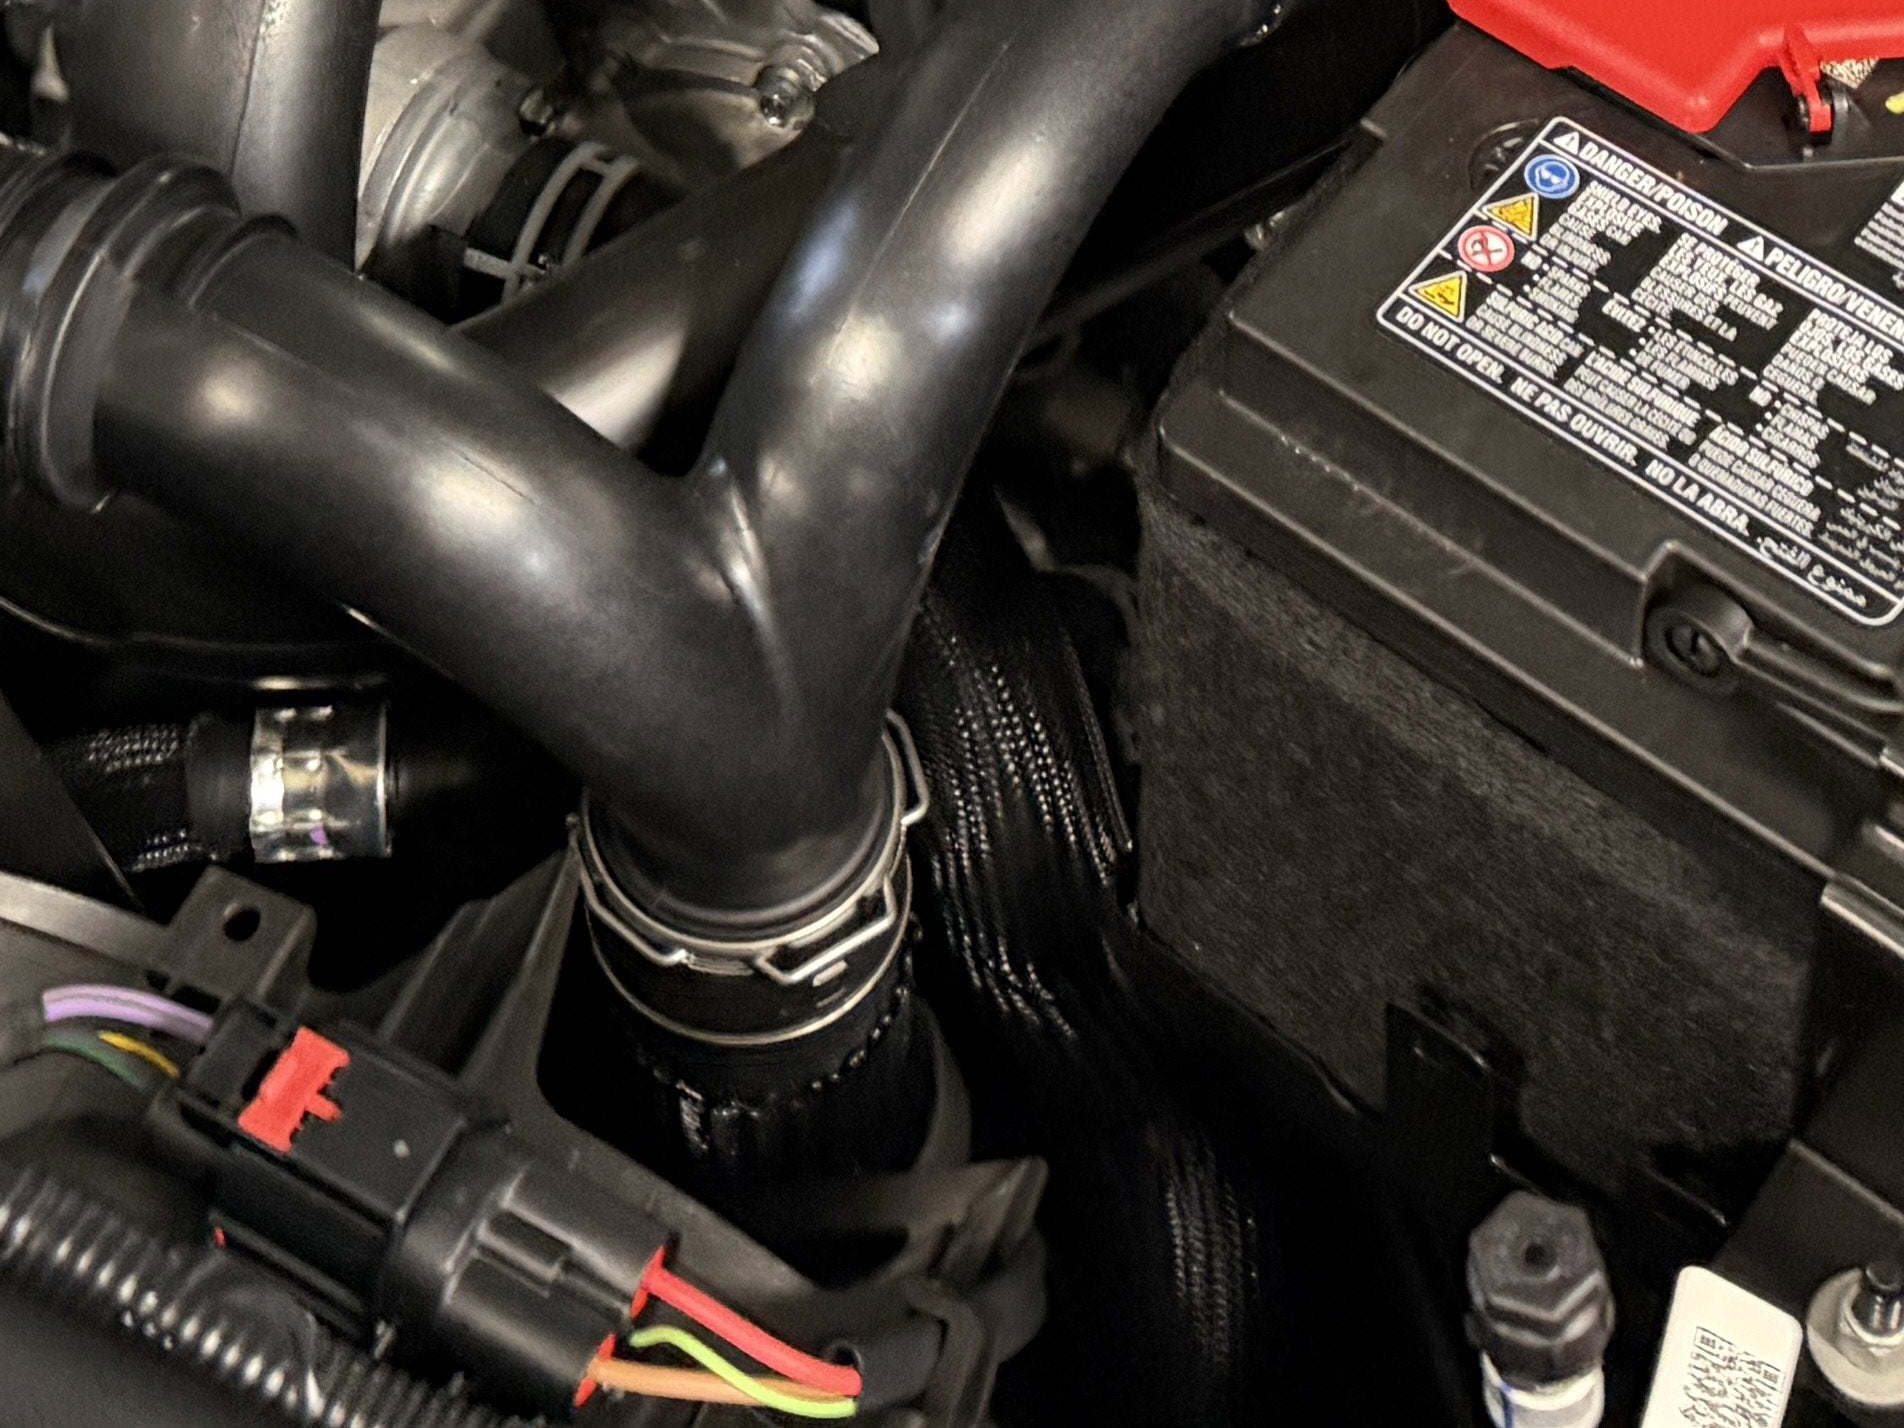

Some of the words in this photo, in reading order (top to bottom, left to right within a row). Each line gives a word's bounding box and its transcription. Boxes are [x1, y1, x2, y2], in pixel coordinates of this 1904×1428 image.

[1576, 141, 1732, 236] DANGER/POISON
[1833, 340, 1866, 365] LOS
[1862, 339, 1896, 364] LOS
[1394, 306, 1426, 331] DO
[1419, 321, 1460, 352] NOT
[1453, 343, 1511, 384] OPEN.
[1509, 377, 1541, 402] NE
[1534, 392, 1573, 422] PAS
[1566, 412, 1646, 467] OUVRIR.
[1643, 459, 1678, 487] NO
[1670, 476, 1703, 502] LA
[1693, 491, 1758, 537] ABRA.
